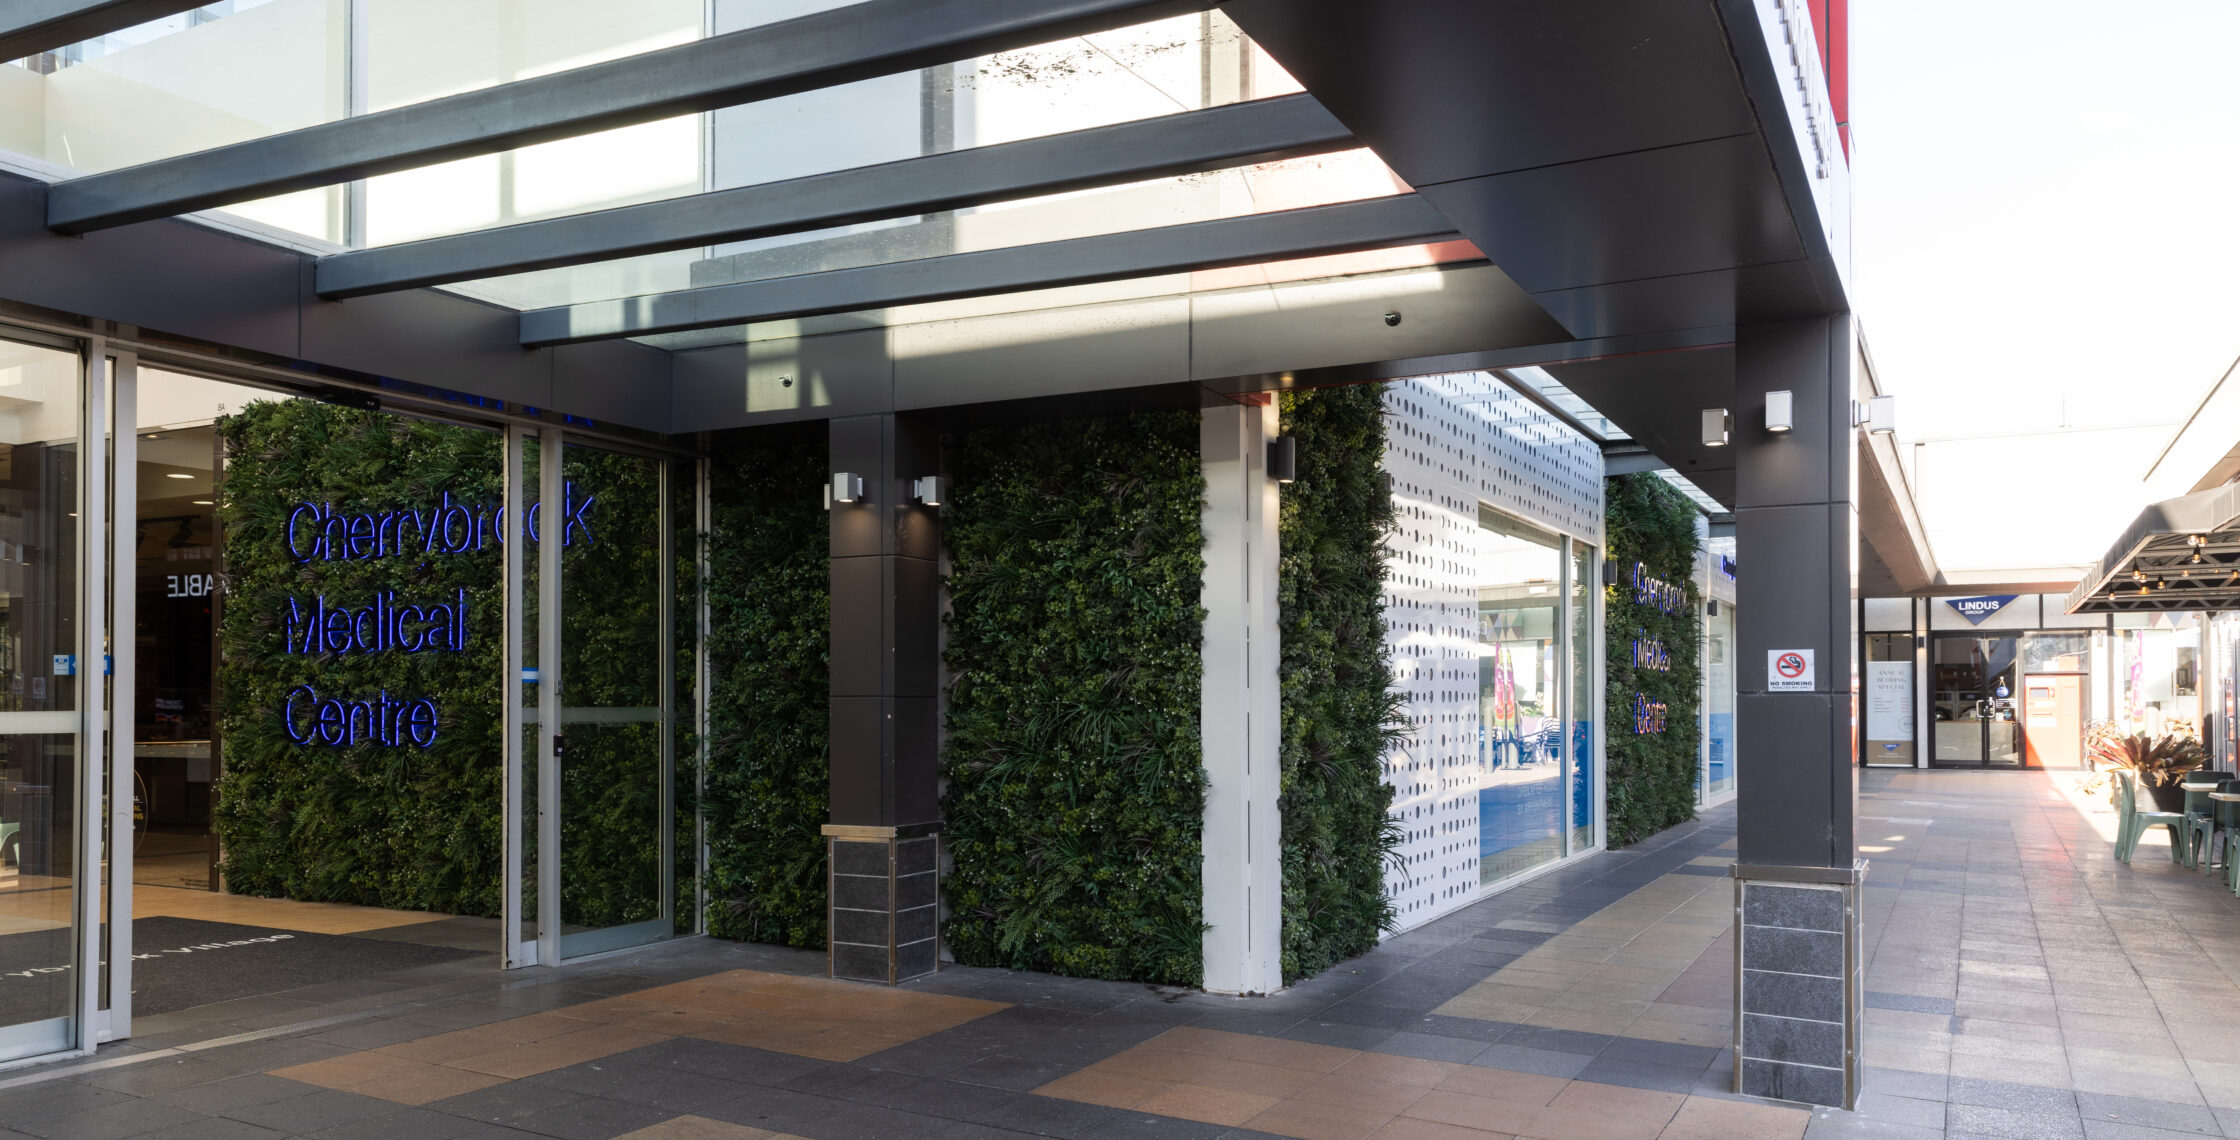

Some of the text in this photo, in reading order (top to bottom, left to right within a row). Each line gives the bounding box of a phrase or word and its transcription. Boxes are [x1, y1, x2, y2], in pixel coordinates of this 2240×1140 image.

[286, 587, 466, 654] Medical
[1958, 601, 2000, 611] LINDUS
[284, 685, 438, 748] Centre
[162, 934, 295, 953] Village
